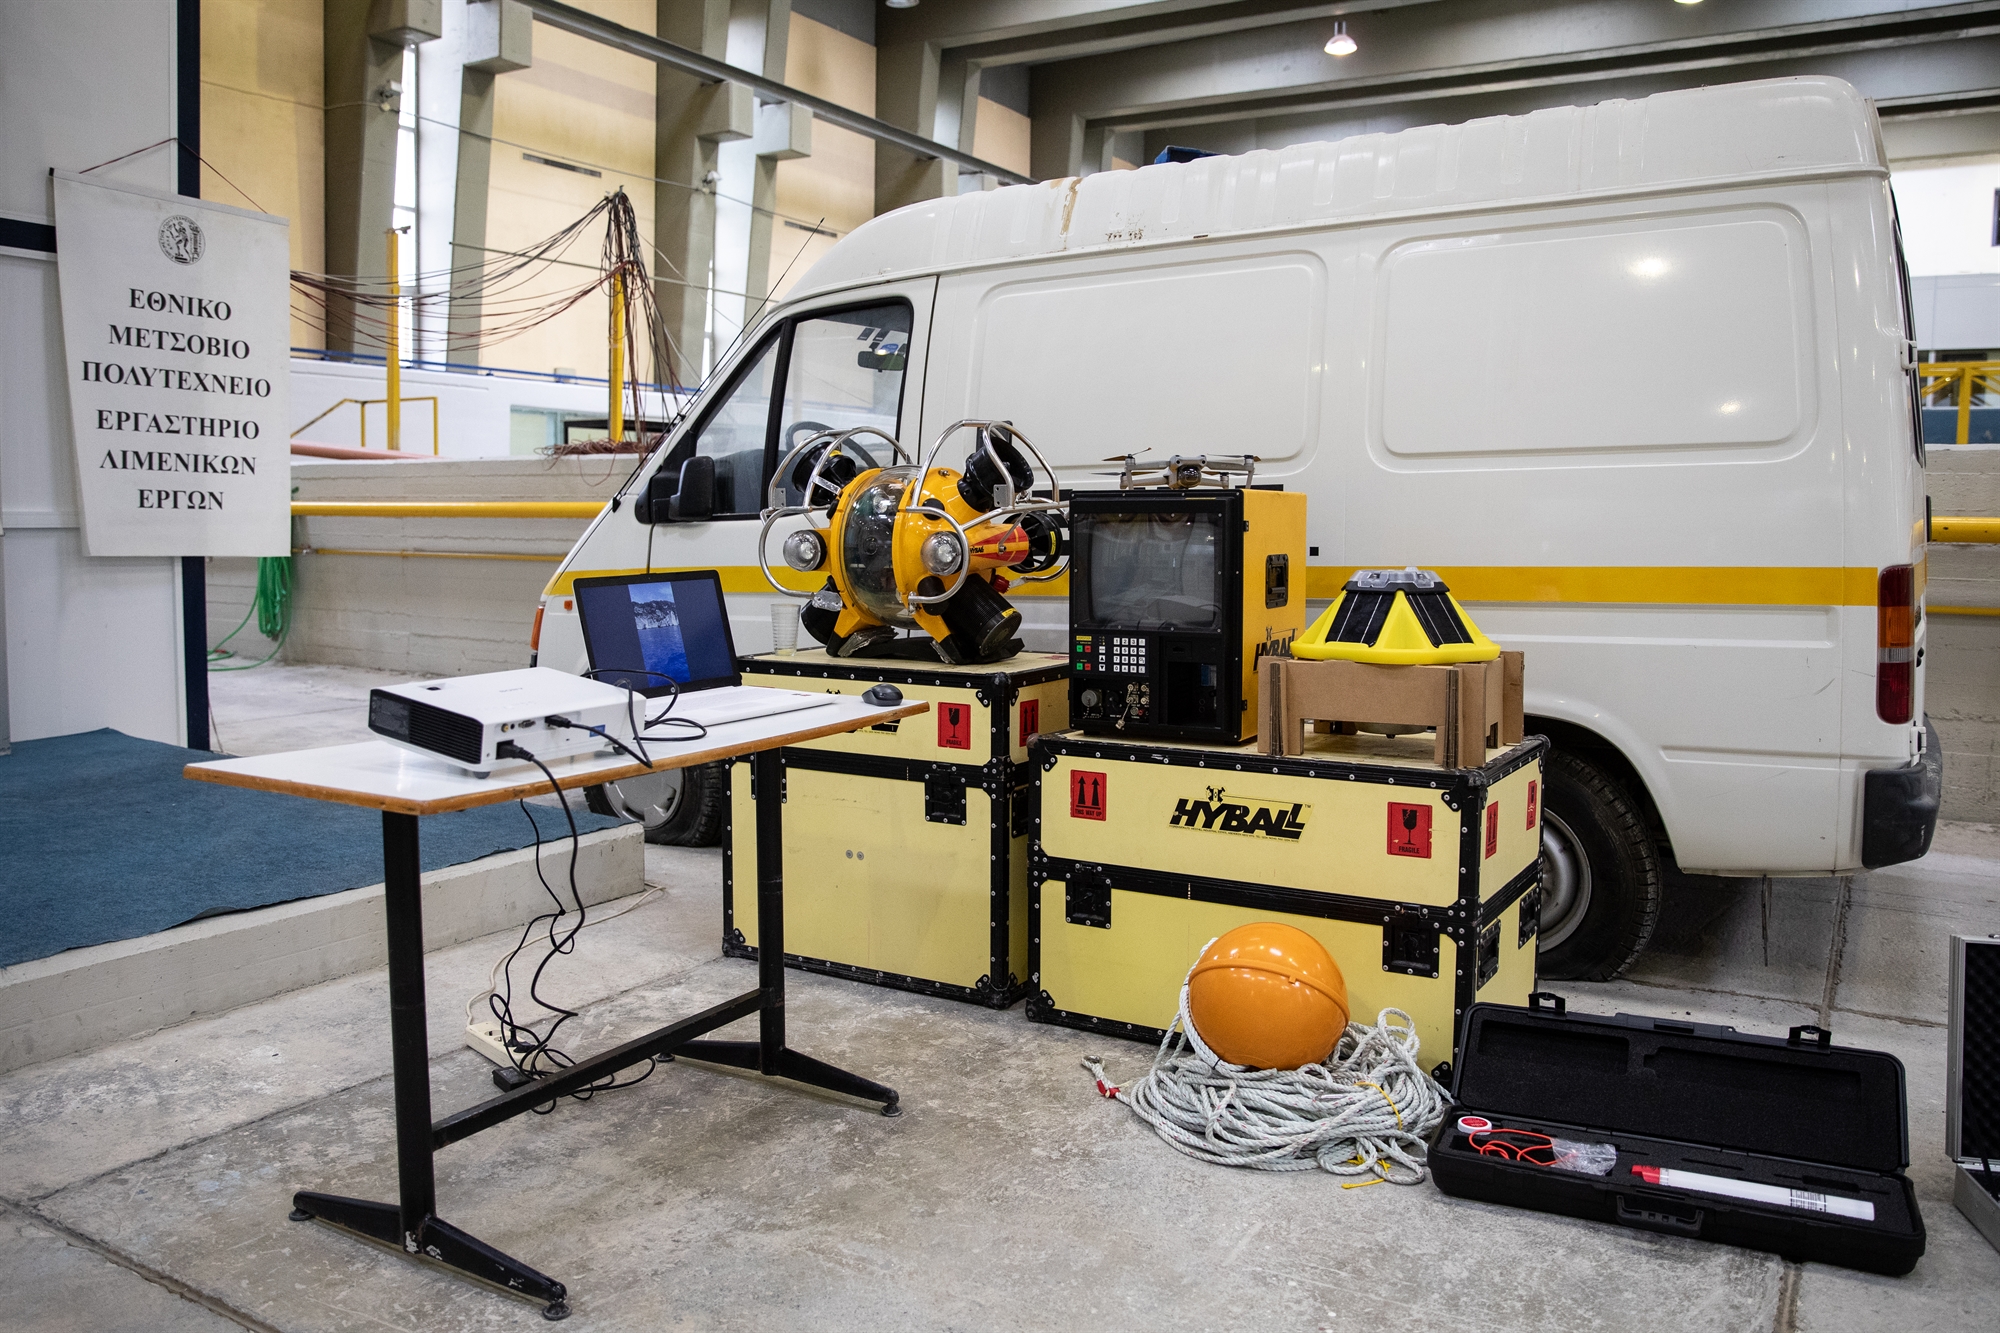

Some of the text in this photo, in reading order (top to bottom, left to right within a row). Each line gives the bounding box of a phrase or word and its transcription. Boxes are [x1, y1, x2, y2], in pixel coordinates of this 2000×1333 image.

[129, 288, 232, 321] ΕΘΝΙΚΟ
[108, 324, 250, 360] ΜΕΤΣΟΒΙΟ
[81, 360, 271, 398] ΠΟΛΥΤΕΧΝΕΙΟ
[95, 409, 260, 440] ΕΡΓΑΣΤΗΡΙΟ
[99, 449, 257, 475] ΛΙΜΕΝΙΚΩΝ
[137, 488, 224, 510] ΕΡΓΩΝ
[1169, 798, 1306, 839] HYBALL
[1398, 845, 1420, 854] FRAGILE
